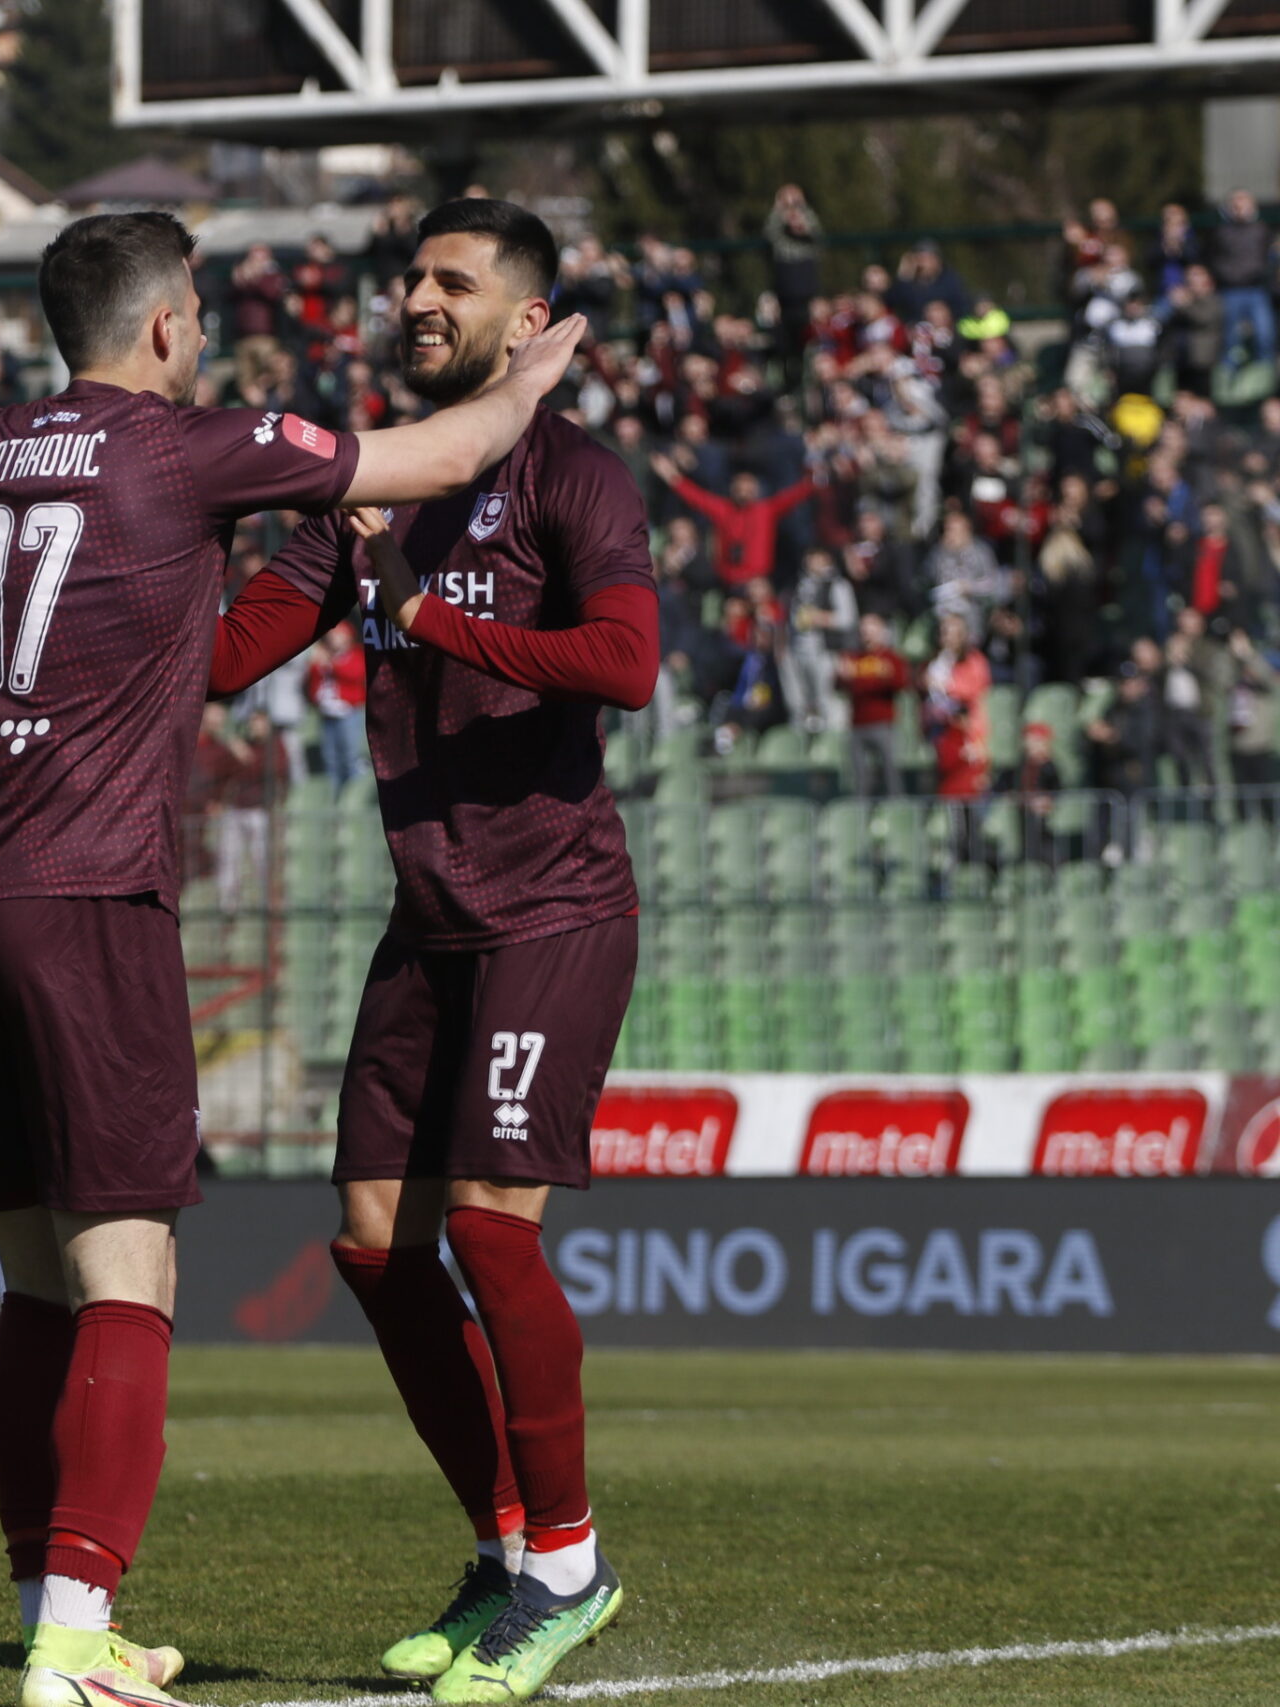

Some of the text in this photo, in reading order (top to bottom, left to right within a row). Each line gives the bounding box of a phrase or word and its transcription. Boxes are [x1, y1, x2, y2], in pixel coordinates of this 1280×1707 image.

[488, 1031, 546, 1100] 27
[438, 1226, 1115, 1318] SINO IGARA
